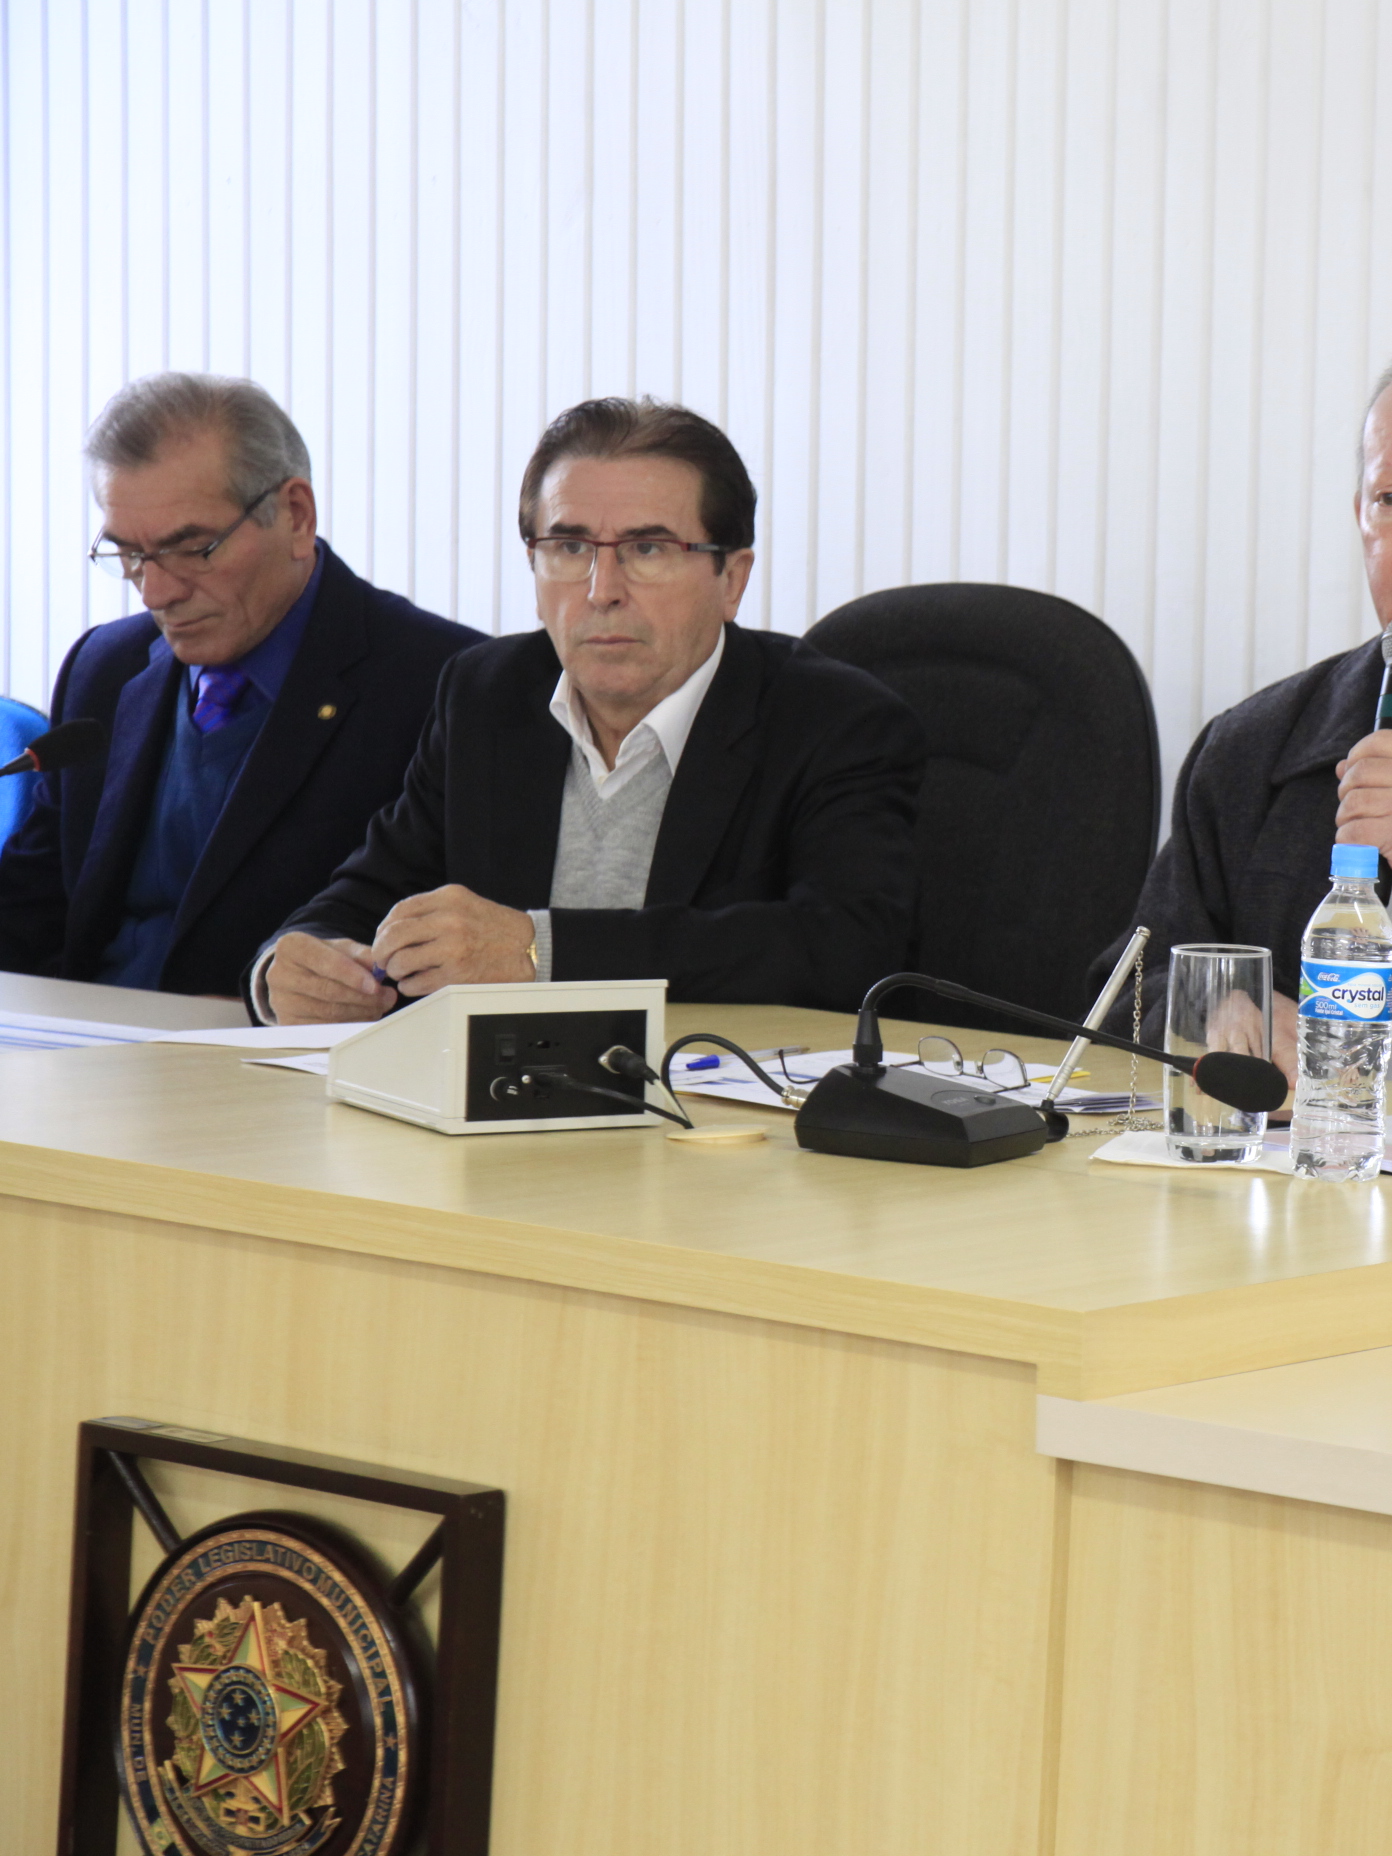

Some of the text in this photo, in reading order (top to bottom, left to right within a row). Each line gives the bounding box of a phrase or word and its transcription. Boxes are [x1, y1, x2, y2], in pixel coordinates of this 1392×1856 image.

[1331, 986, 1385, 1003] crystal
[143, 1541, 393, 1711] PODER LEGISLATIVO MUNICIPAL
